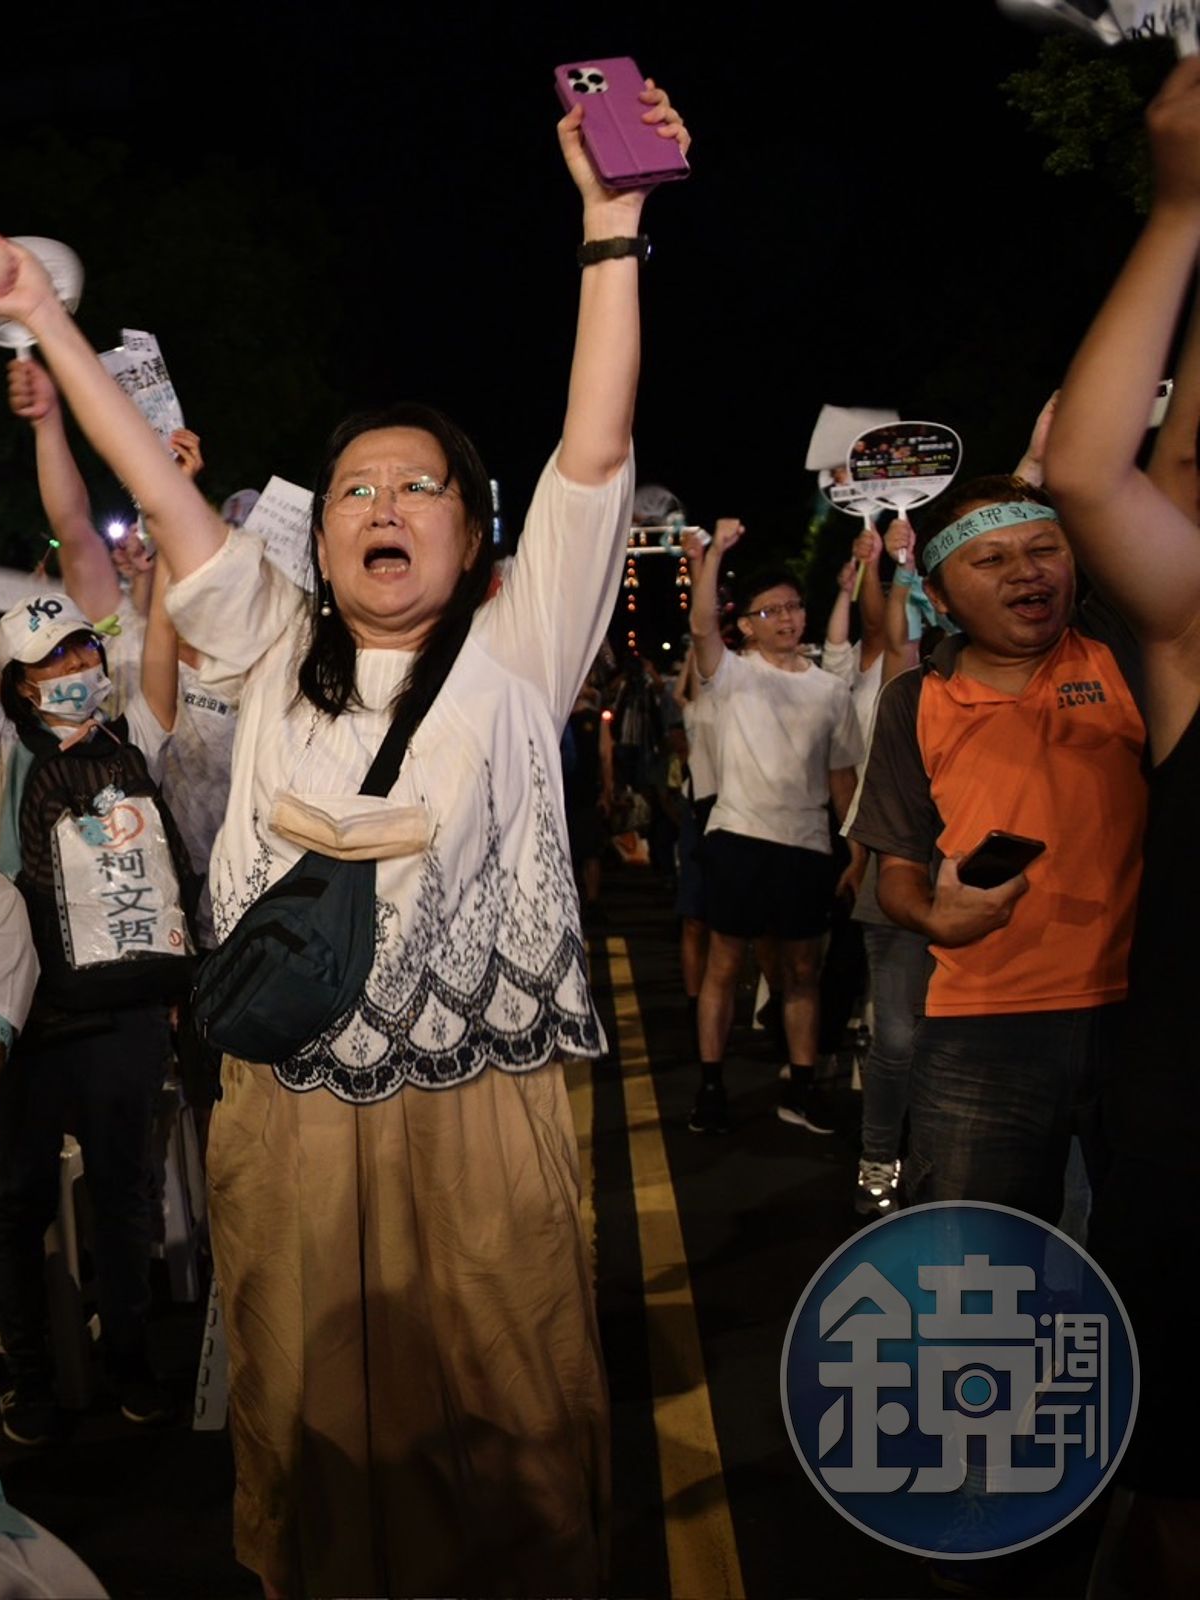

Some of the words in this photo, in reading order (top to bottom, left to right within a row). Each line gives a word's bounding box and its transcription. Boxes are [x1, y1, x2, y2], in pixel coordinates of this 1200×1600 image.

[184, 692, 228, 716] 政治迫害
[95, 848, 158, 953] 柯文哲
